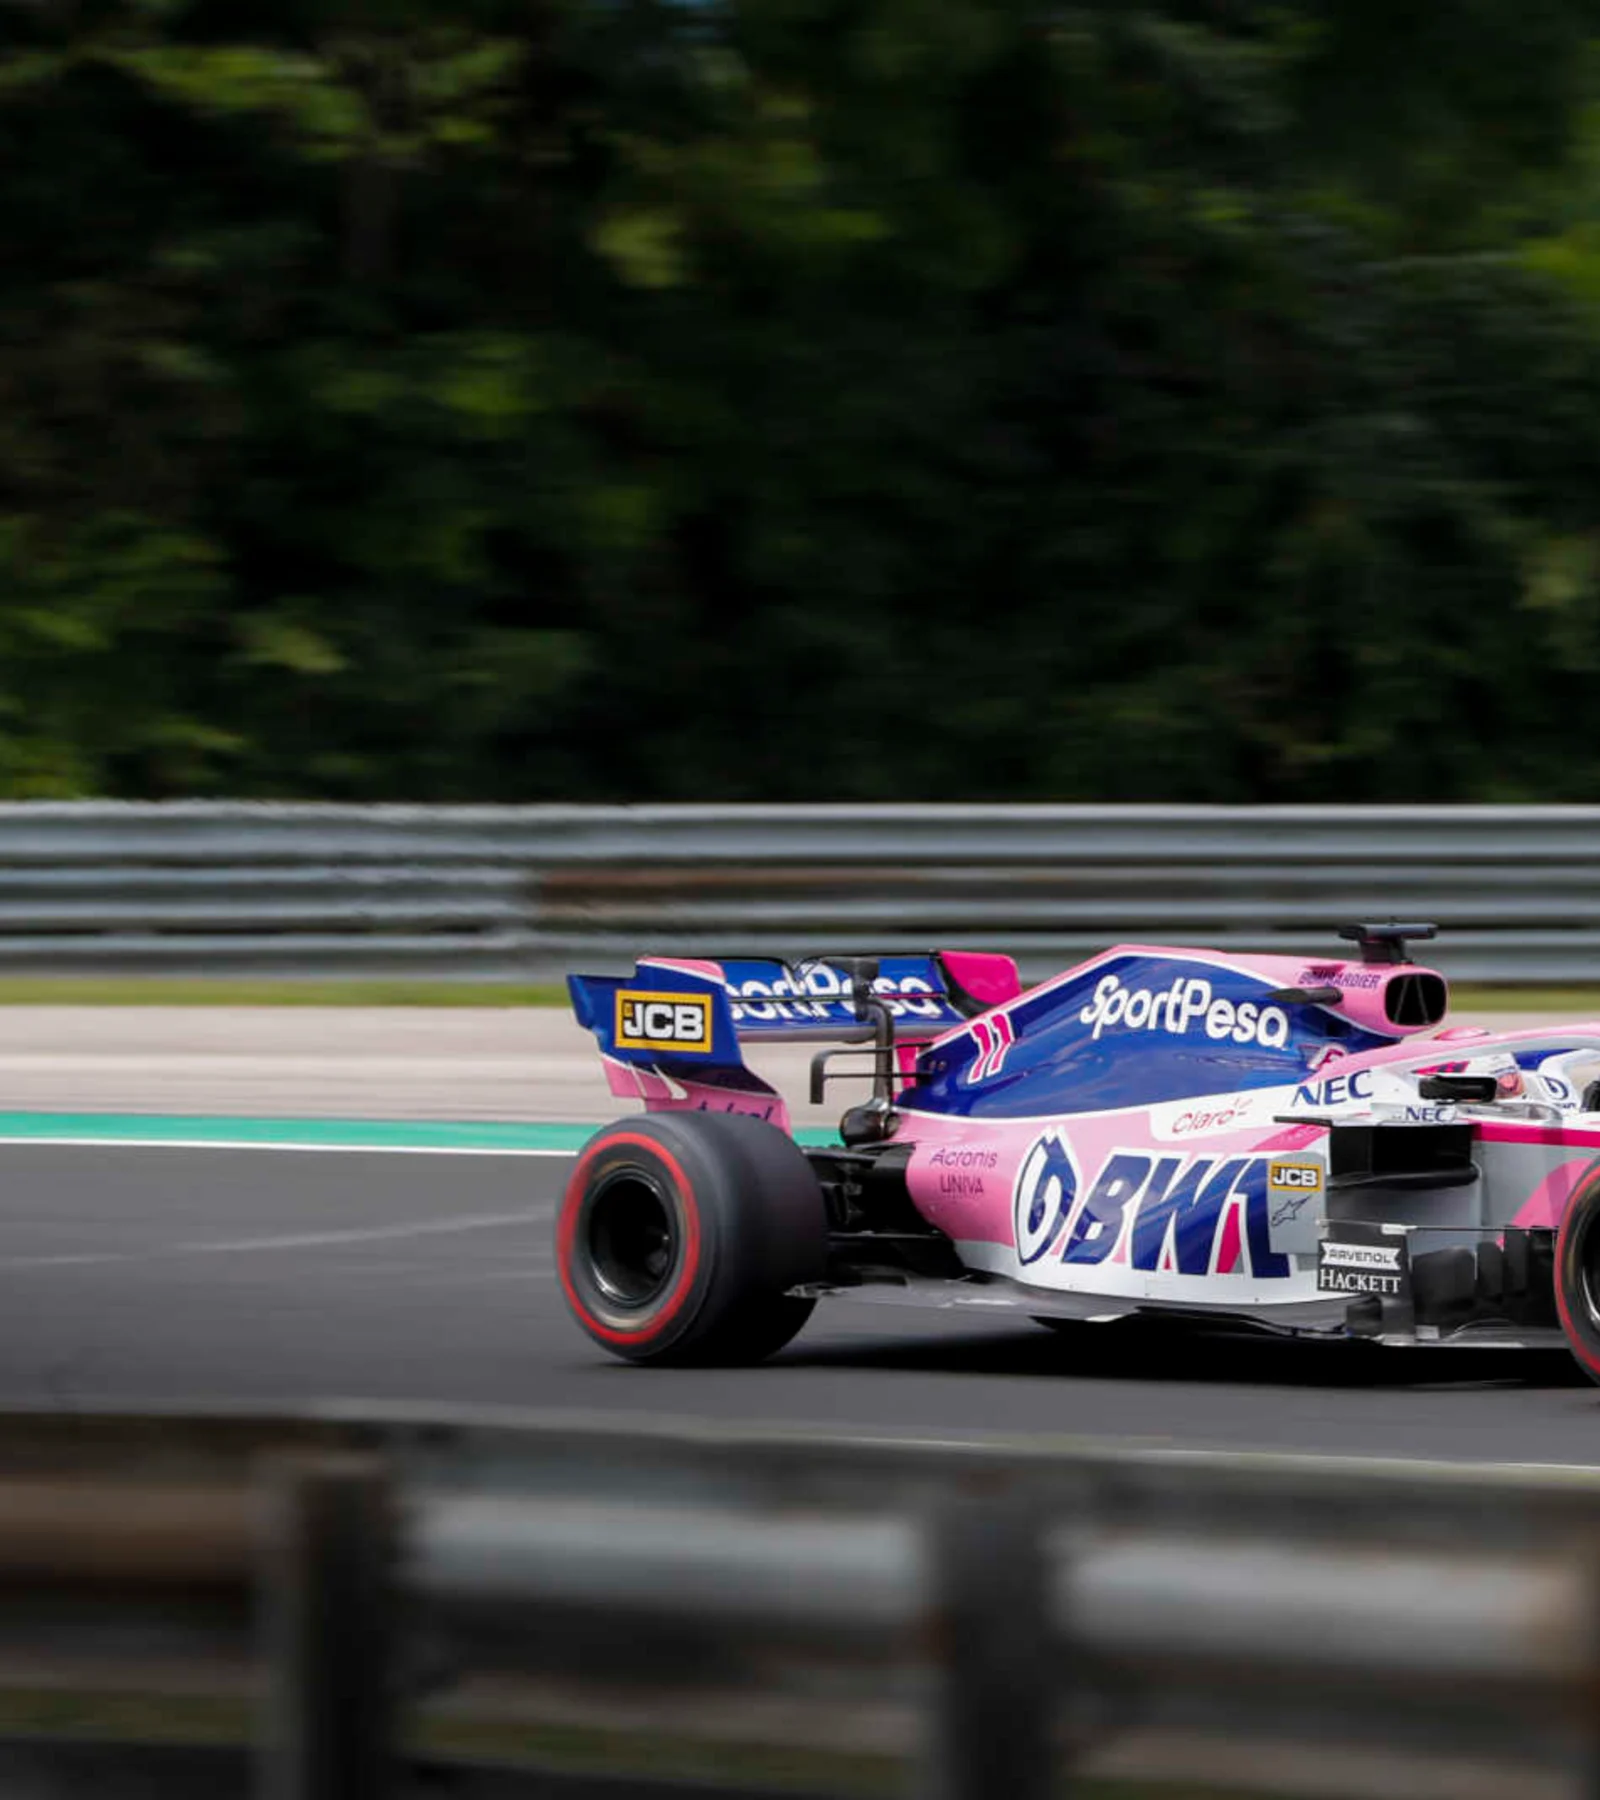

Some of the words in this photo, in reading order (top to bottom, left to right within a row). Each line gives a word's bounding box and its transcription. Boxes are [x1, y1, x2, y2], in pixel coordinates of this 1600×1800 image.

[623, 1003, 703, 1040] JCB
[1080, 975, 1289, 1050] SportPesa
[968, 1011, 1015, 1084] 11
[1292, 1069, 1373, 1107] NEC
[1172, 1110, 1235, 1134] Claro
[1405, 1106, 1448, 1122] NEC
[929, 1148, 997, 1168] Acronis
[941, 1174, 984, 1193] UNIVA
[1273, 1168, 1317, 1187] JCB
[1329, 1249, 1392, 1264] RAVENOL
[1320, 1268, 1401, 1293] HACKETT
